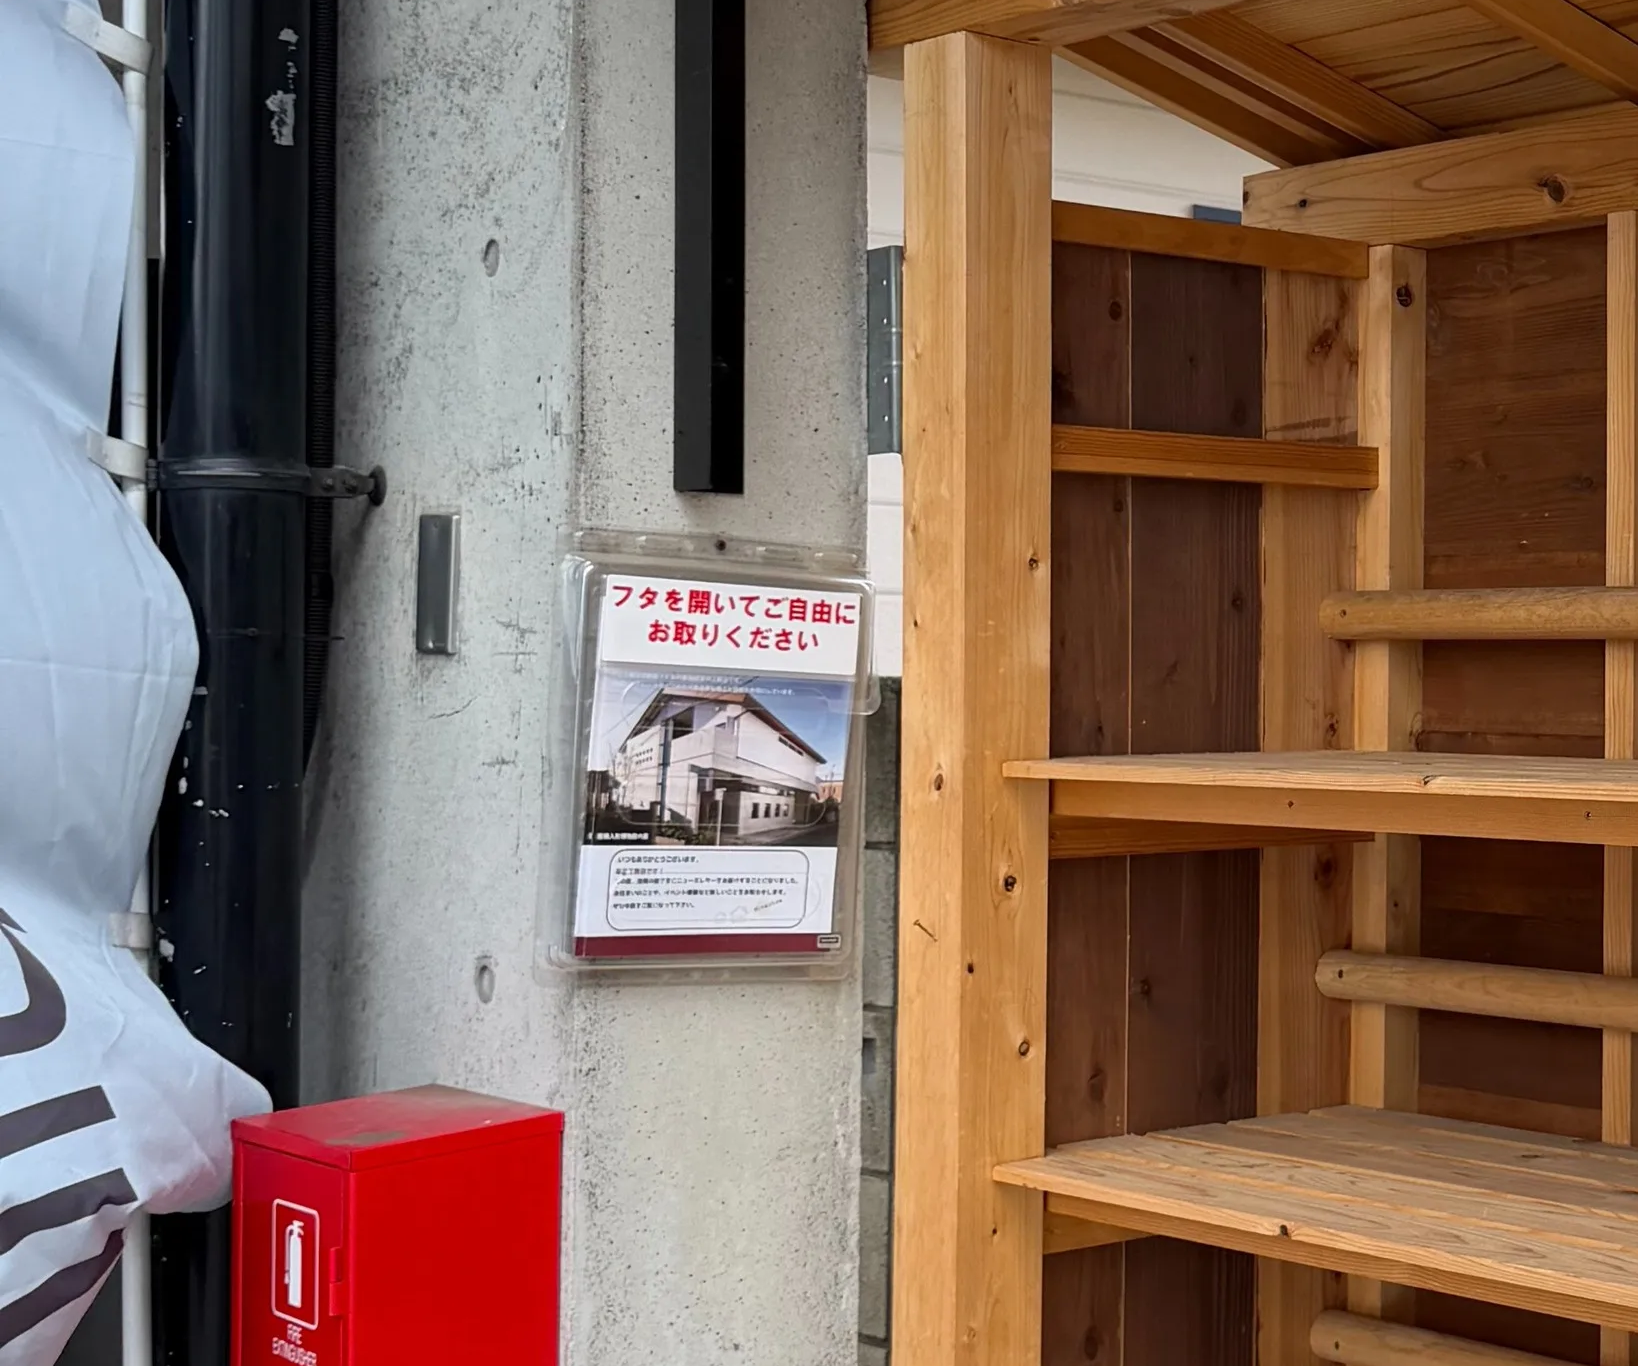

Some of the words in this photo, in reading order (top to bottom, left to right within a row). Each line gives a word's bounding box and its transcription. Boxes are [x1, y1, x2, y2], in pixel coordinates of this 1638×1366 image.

[611, 584, 856, 625] フタを開いてご自由に
[648, 620, 819, 652] お取りください
[286, 1323, 303, 1345] FIRE
